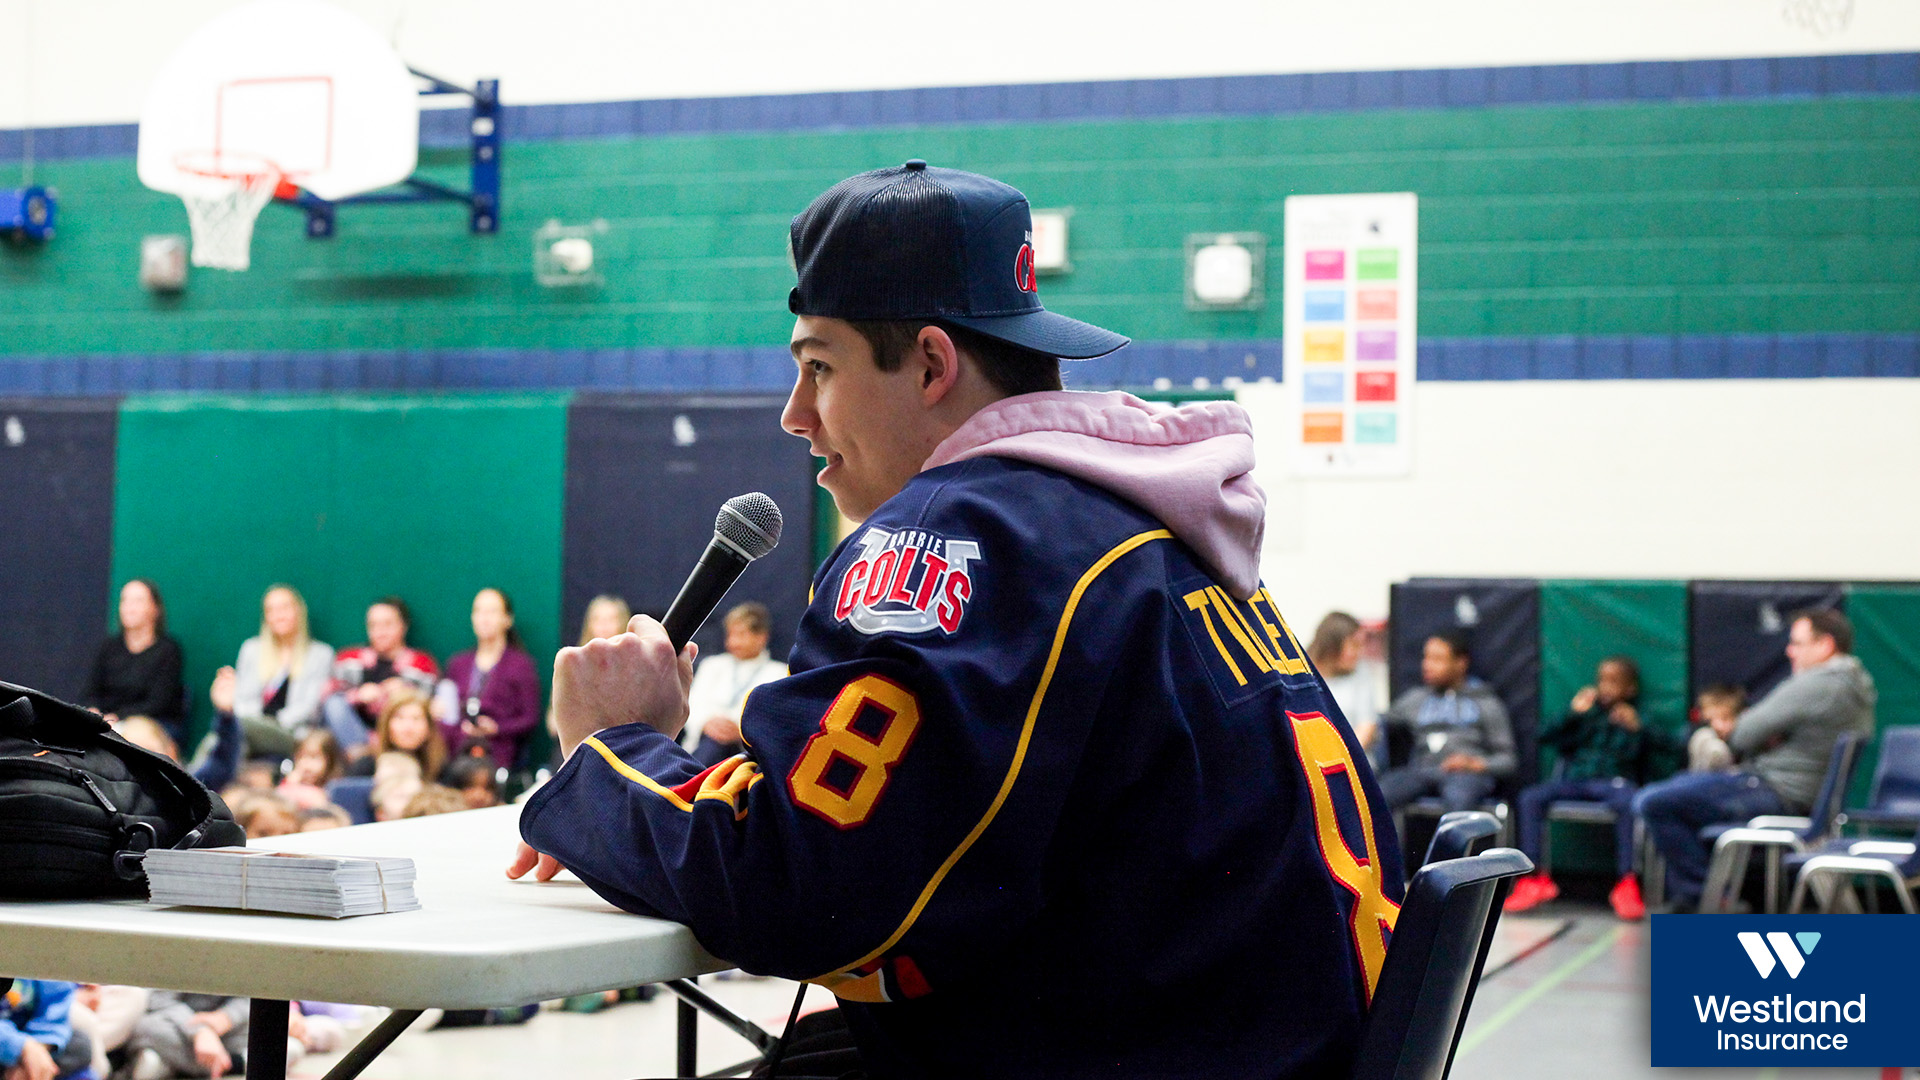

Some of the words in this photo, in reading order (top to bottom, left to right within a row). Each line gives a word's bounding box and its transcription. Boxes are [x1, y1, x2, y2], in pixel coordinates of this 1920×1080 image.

[834, 545, 973, 635] COLTS
[888, 530, 943, 554] BARRIE
[1182, 585, 1314, 687] TILE
[786, 672, 924, 830] 8
[1285, 710, 1401, 1012] 8
